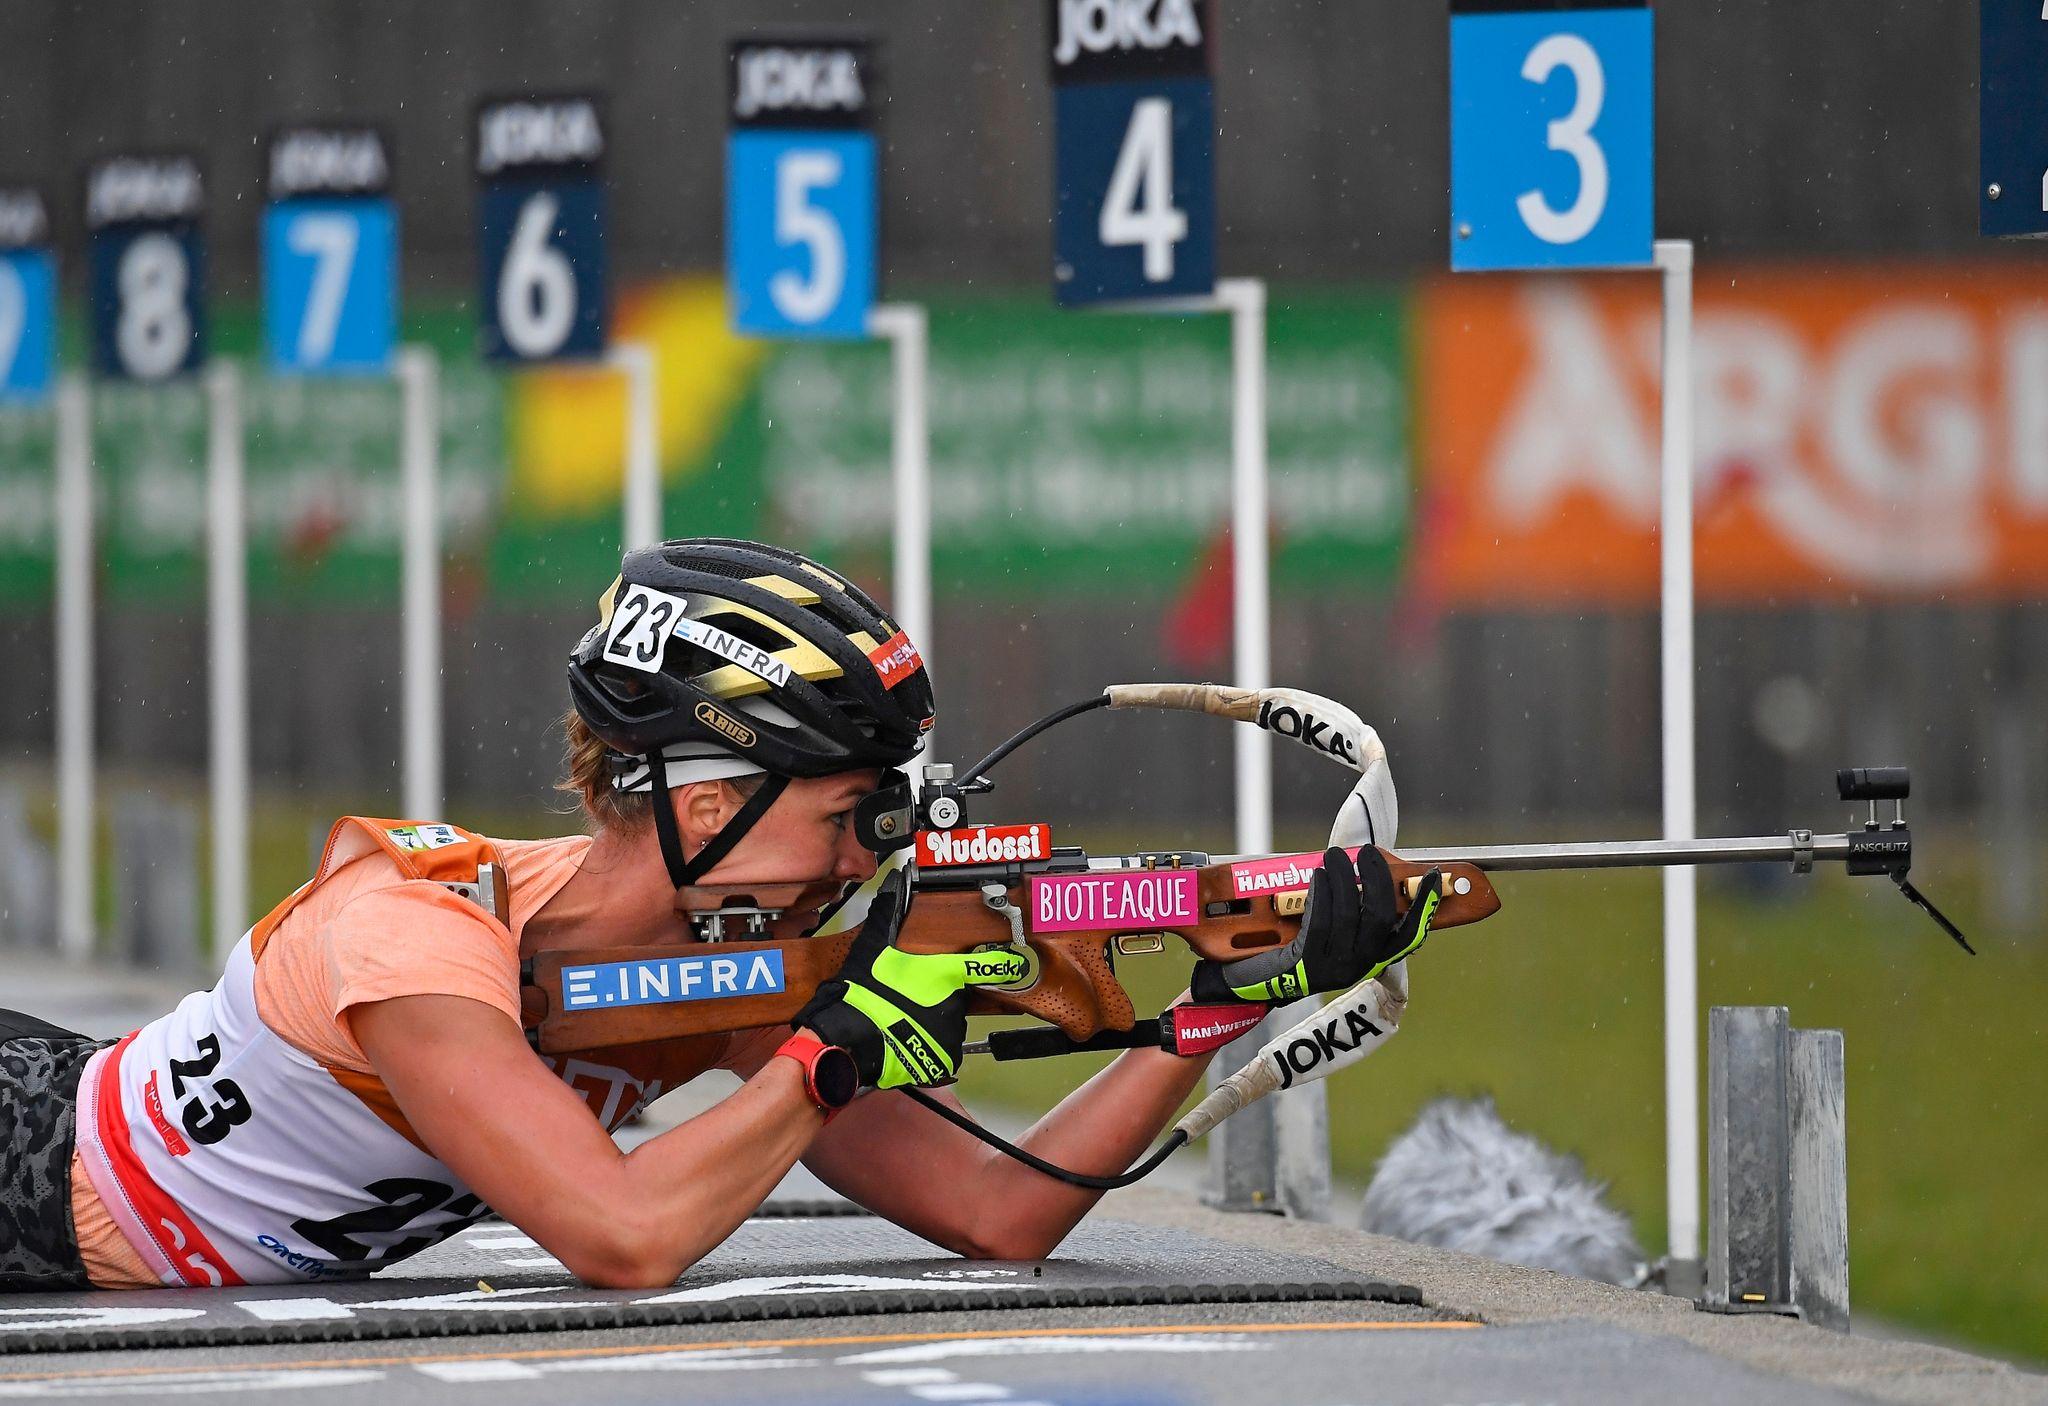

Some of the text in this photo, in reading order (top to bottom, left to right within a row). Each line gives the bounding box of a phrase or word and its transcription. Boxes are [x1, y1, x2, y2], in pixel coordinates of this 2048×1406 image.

[1056, 0, 1201, 64] JOKA
[735, 49, 863, 115] JOKA
[1516, 34, 1608, 244] 3
[1101, 98, 1188, 282] 4
[501, 190, 578, 357] 6
[768, 149, 847, 323] 5
[117, 231, 191, 379] 8
[287, 212, 360, 369] 7
[608, 593, 673, 663] 23
[701, 708, 750, 743] ABUS
[926, 825, 1041, 865] Nudossi
[1234, 868, 1250, 878] DAS
[1039, 877, 1190, 922] BIOTEAQUE
[568, 956, 777, 1005] E.INFRA
[1273, 1008, 1383, 1091] JOKA
[170, 1032, 252, 1145] 23
